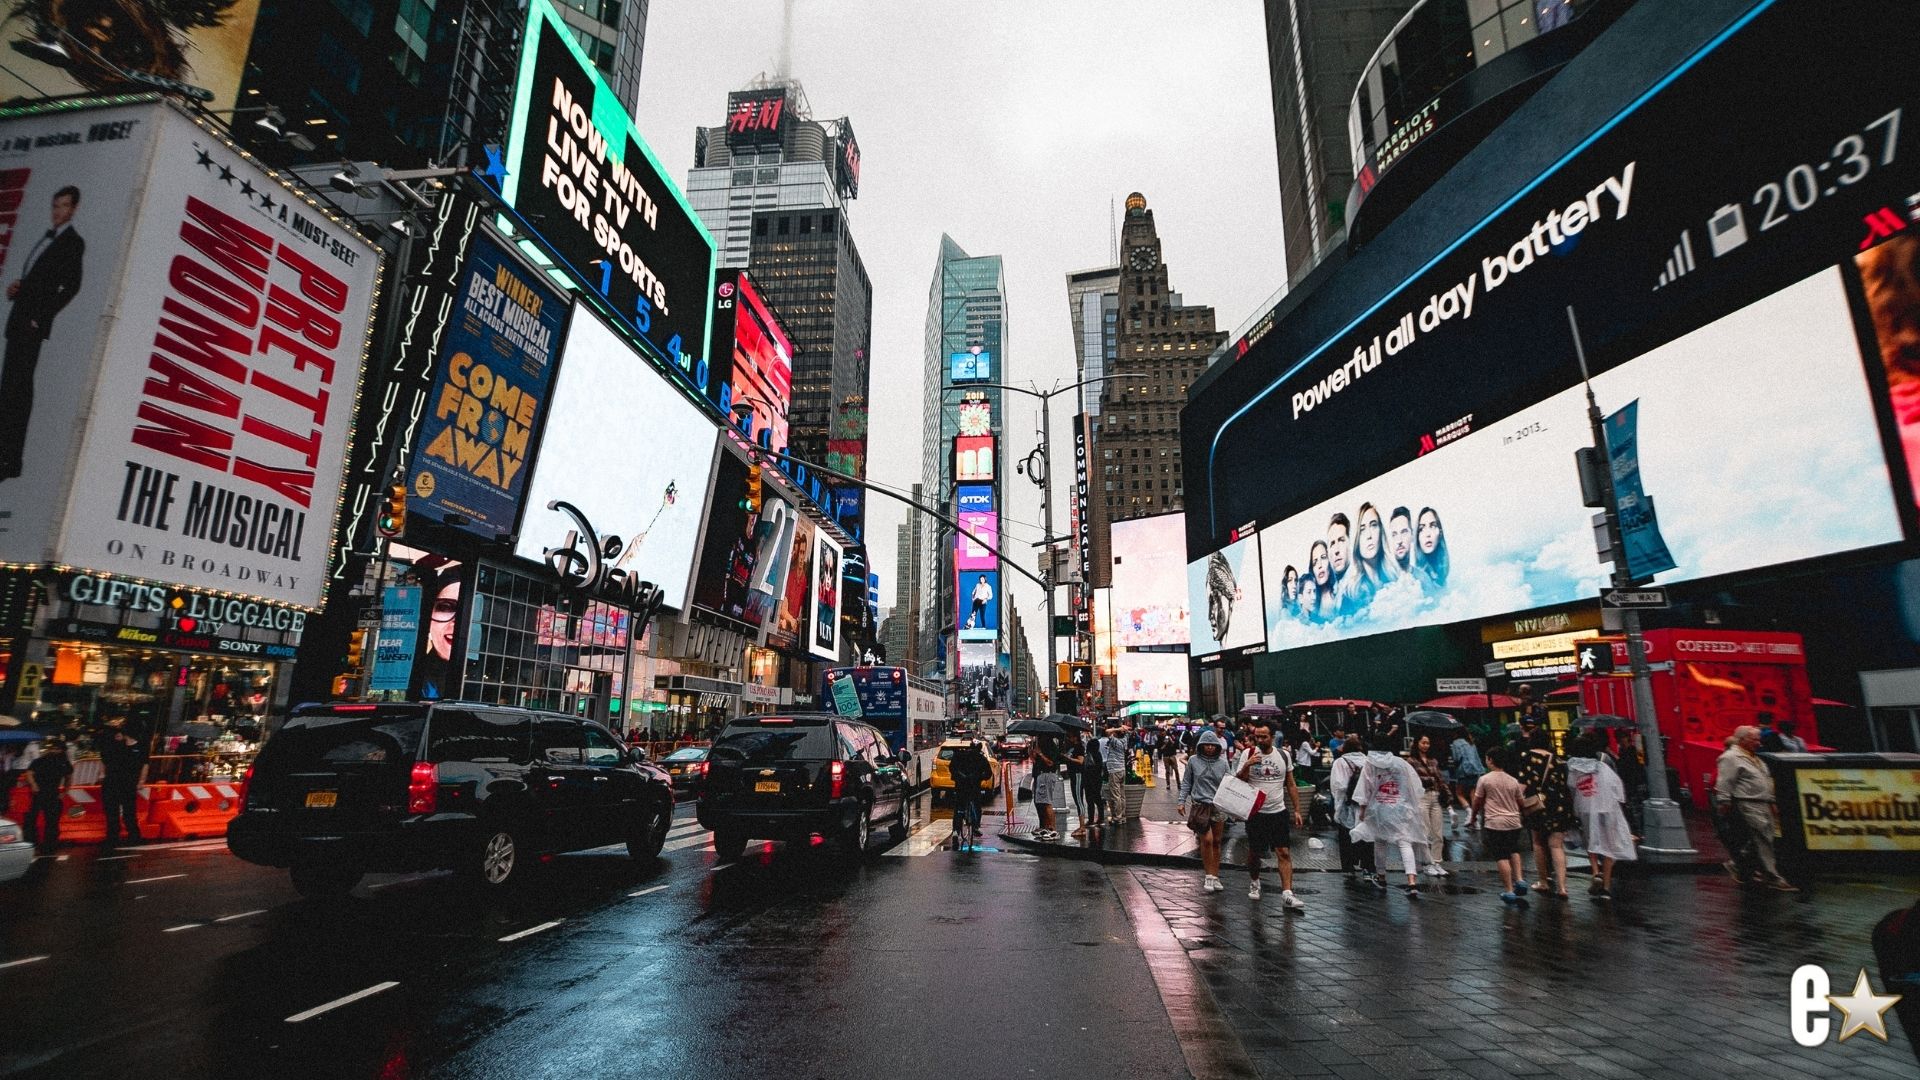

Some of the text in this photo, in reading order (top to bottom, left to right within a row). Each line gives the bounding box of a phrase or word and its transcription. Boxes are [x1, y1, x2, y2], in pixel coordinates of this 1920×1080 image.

[729, 97, 784, 133] H&M
[1375, 98, 1441, 162] MARRIOTT
[548, 114, 631, 230] LIVE TV
[552, 76, 659, 230] NOW WITH
[1377, 118, 1435, 175] MARQUIS
[1752, 107, 1902, 232] 20:37
[278, 203, 289, 224] A
[542, 153, 670, 316] FOR SPORTS.
[468, 271, 504, 315] BEST
[502, 298, 552, 355] MUSICAL
[495, 263, 544, 320] WINNER!
[718, 300, 732, 310] LG
[1291, 161, 1636, 420] Powerful all day battery
[130, 195, 275, 473] WOMAN
[463, 297, 478, 316] ALL
[477, 305, 505, 335] ACROSS
[504, 325, 524, 349] NORTH
[522, 340, 549, 367] AMERICA
[232, 242, 349, 509] PRETTY
[448, 352, 538, 429] COME
[965, 391, 985, 401] 2018
[1435, 413, 1474, 437] MARRIOTT
[1436, 425, 1471, 446] MARQUIS
[1503, 436, 1514, 446] In
[424, 424, 524, 490] AWAY
[116, 460, 307, 562] THE MUSICAL
[969, 495, 990, 504] TDK
[1075, 433, 1090, 573] COMMUNICATE
[106, 539, 300, 590] ON BROADWAY
[540, 499, 665, 641] Disney
[69, 574, 307, 633] GIFTS LUGGAGE
[384, 608, 415, 616] WINNER
[1514, 613, 1571, 634] INVICTA
[1610, 593, 1658, 602] ONE WAY
[115, 626, 158, 643] Nikon
[164, 633, 211, 649] Canon
[195, 620, 224, 637] NY
[218, 639, 263, 654] SONY
[380, 639, 403, 647] DEAR
[698, 692, 727, 709] FOREVER
